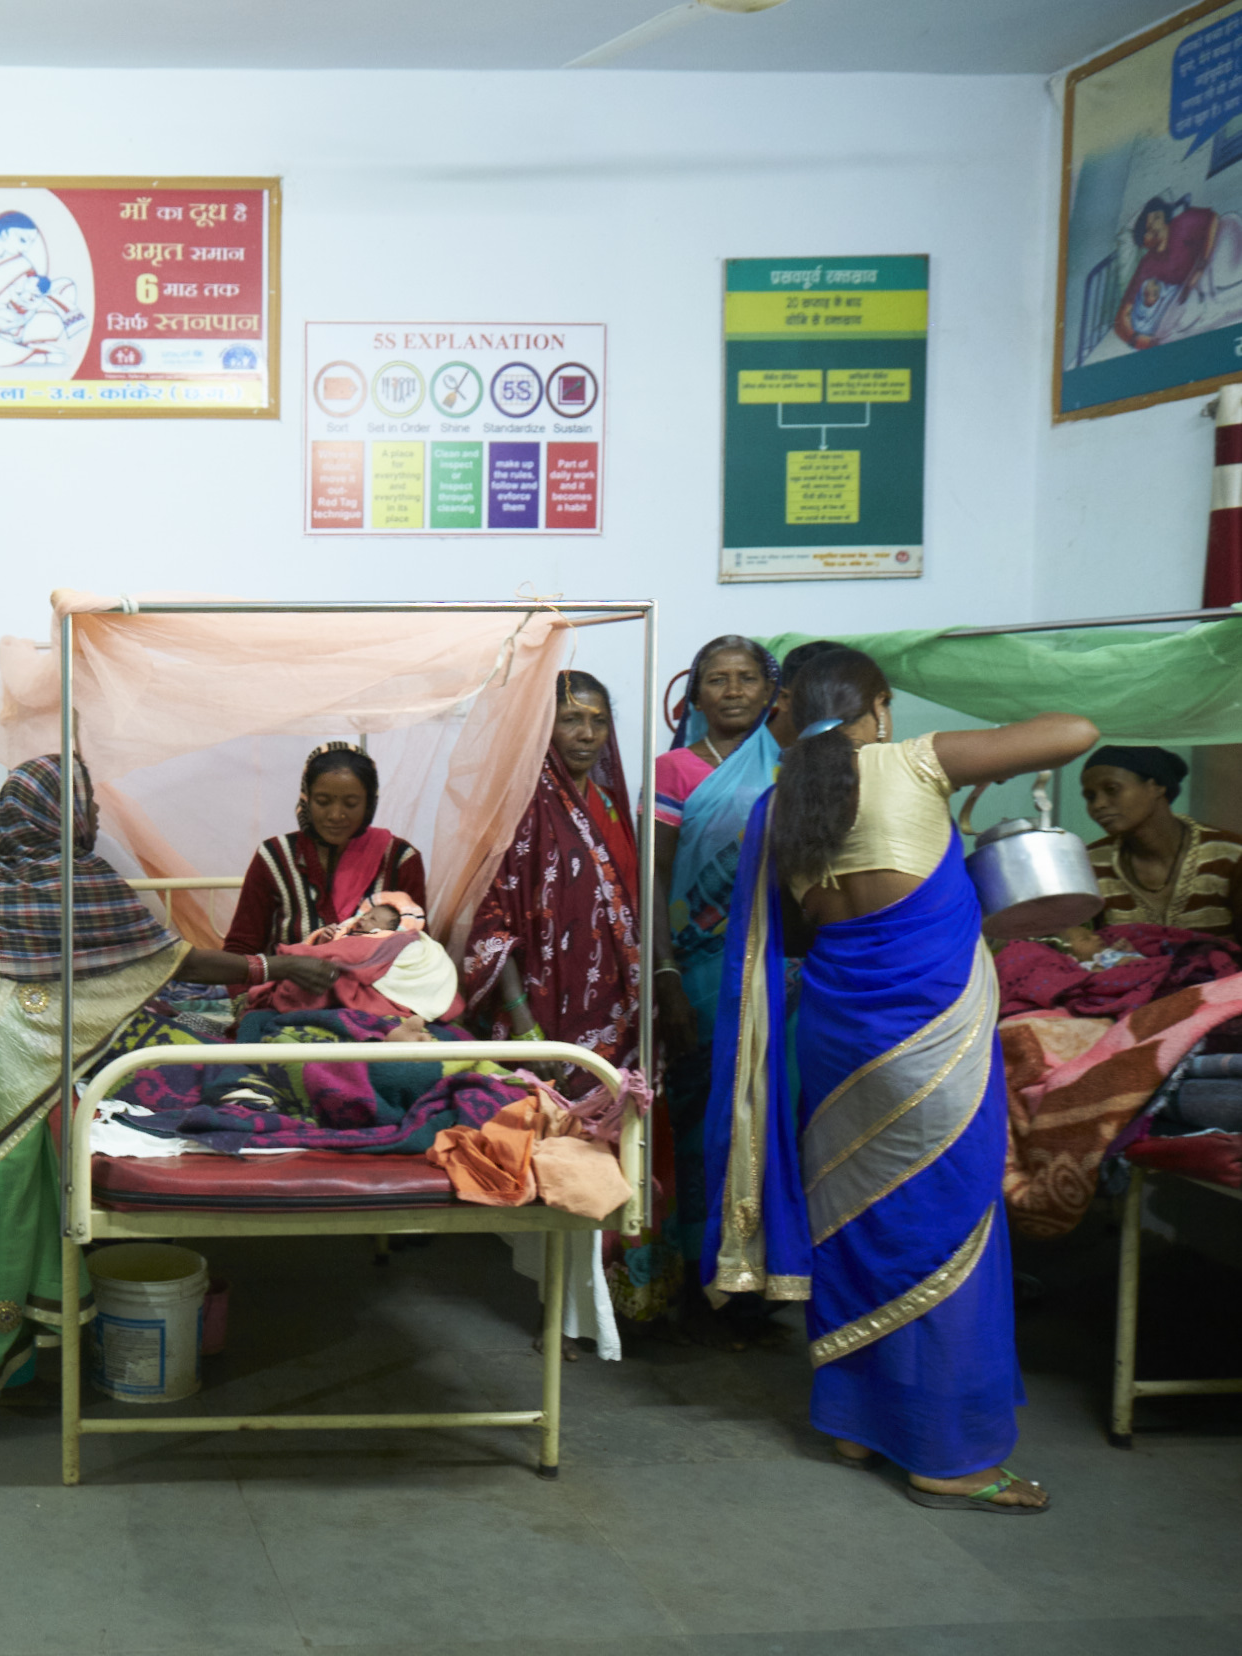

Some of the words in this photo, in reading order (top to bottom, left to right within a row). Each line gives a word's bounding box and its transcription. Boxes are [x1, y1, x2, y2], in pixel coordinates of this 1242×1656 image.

[119, 196, 152, 220] माँ
[157, 206, 183, 221] का
[189, 203, 228, 227] दूध
[233, 203, 248, 222] है
[122, 243, 184, 267] अमृत
[190, 247, 245, 261] समान
[136, 273, 159, 304] 6
[163, 282, 198, 298] माह
[203, 282, 240, 298] तक
[106, 312, 149, 332] सिर्फ
[153, 313, 260, 332] स्तनपान
[373, 332, 397, 350] 5S
[404, 332, 566, 350] EXPLANATION
[100, 384, 162, 400] कांकेर
[502, 380, 532, 401] 5S
[326, 423, 349, 434] Sort
[367, 423, 386, 434] Set
[388, 423, 398, 434] in
[401, 423, 430, 434] Order
[440, 423, 471, 434] Shine
[483, 423, 546, 434] Standardize
[553, 423, 593, 434] Sustain
[382, 449, 389, 458] A
[390, 450, 414, 460] place
[434, 449, 460, 459] Clean
[462, 449, 479, 459] and
[392, 460, 404, 468] for
[496, 459, 520, 468] make
[522, 460, 534, 470] up
[557, 458, 576, 468] Part
[578, 458, 589, 468] of
[374, 472, 422, 481] everything
[451, 471, 462, 480] or
[494, 470, 508, 480] the
[550, 470, 571, 481] daily
[573, 470, 595, 480] work
[390, 482, 406, 491] and
[492, 481, 519, 490] follow
[521, 481, 538, 490] and
[559, 481, 576, 491] and
[374, 494, 421, 503] everything
[438, 492, 474, 503] through
[551, 492, 592, 501] becomes
[318, 497, 337, 507] Red
[340, 497, 358, 509] Tag
[437, 503, 475, 514] cleaning
[502, 502, 525, 512] them
[564, 502, 588, 513] habit
[313, 509, 361, 521] technique
[385, 515, 409, 525] place
